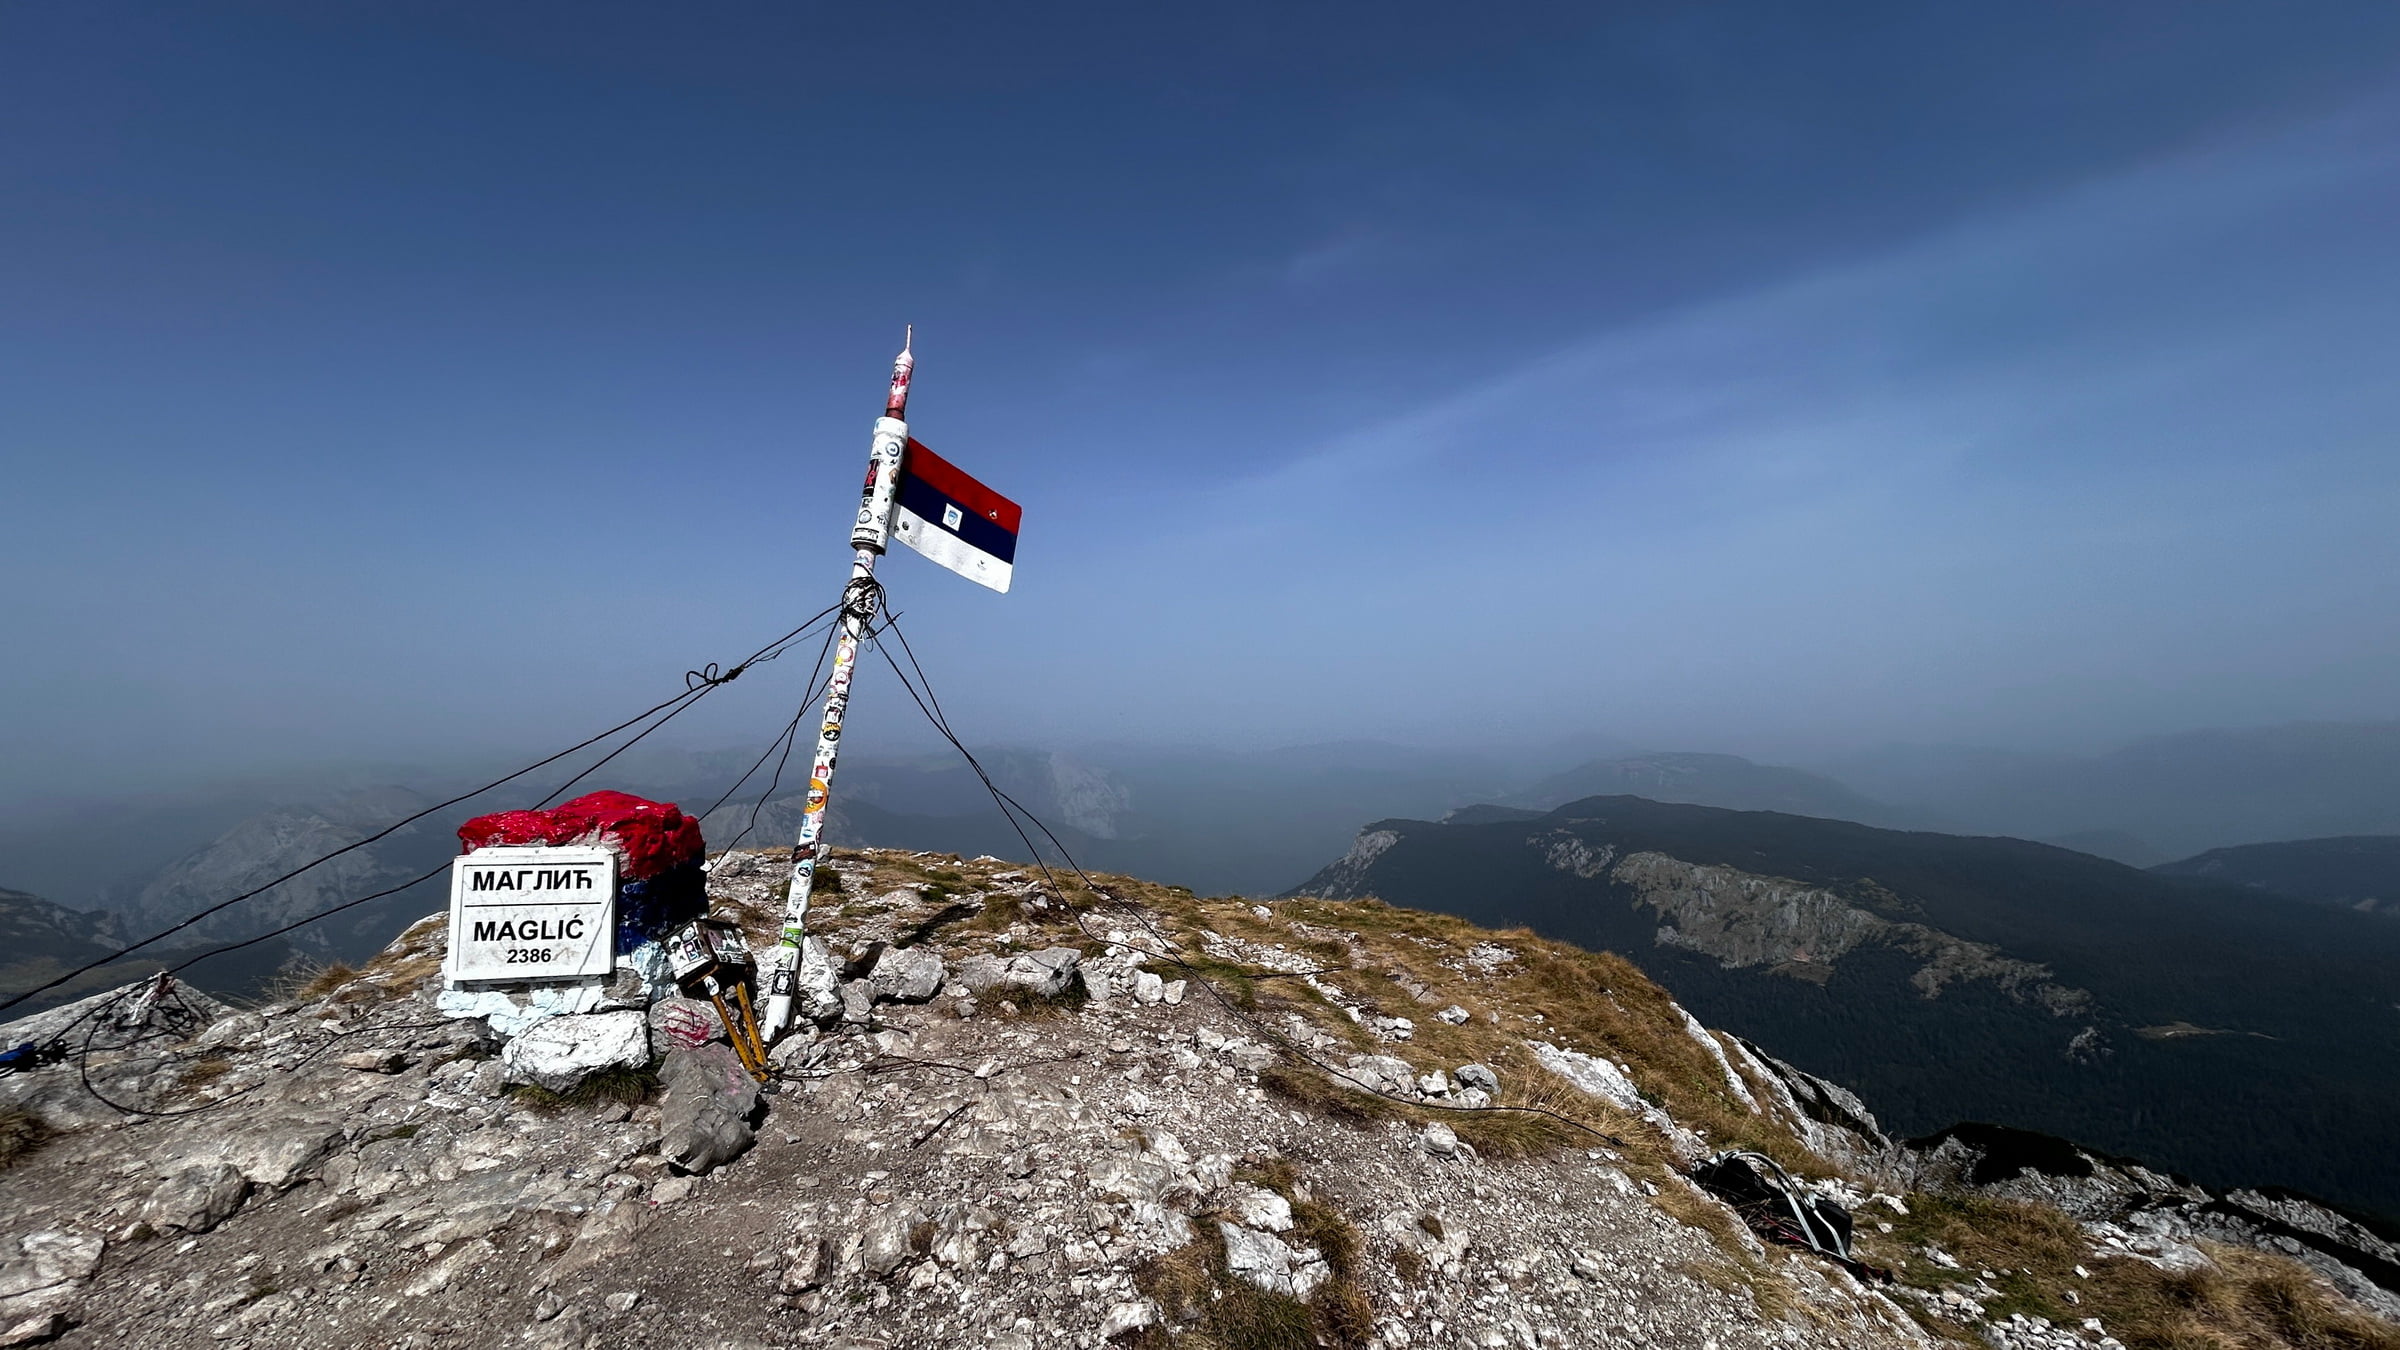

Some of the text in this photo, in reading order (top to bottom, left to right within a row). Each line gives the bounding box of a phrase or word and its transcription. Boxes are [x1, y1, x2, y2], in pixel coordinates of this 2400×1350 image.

[472, 869, 592, 891] МАГЛИЋ
[473, 914, 584, 942] MAGLIĆ
[507, 948, 552, 964] 2386
